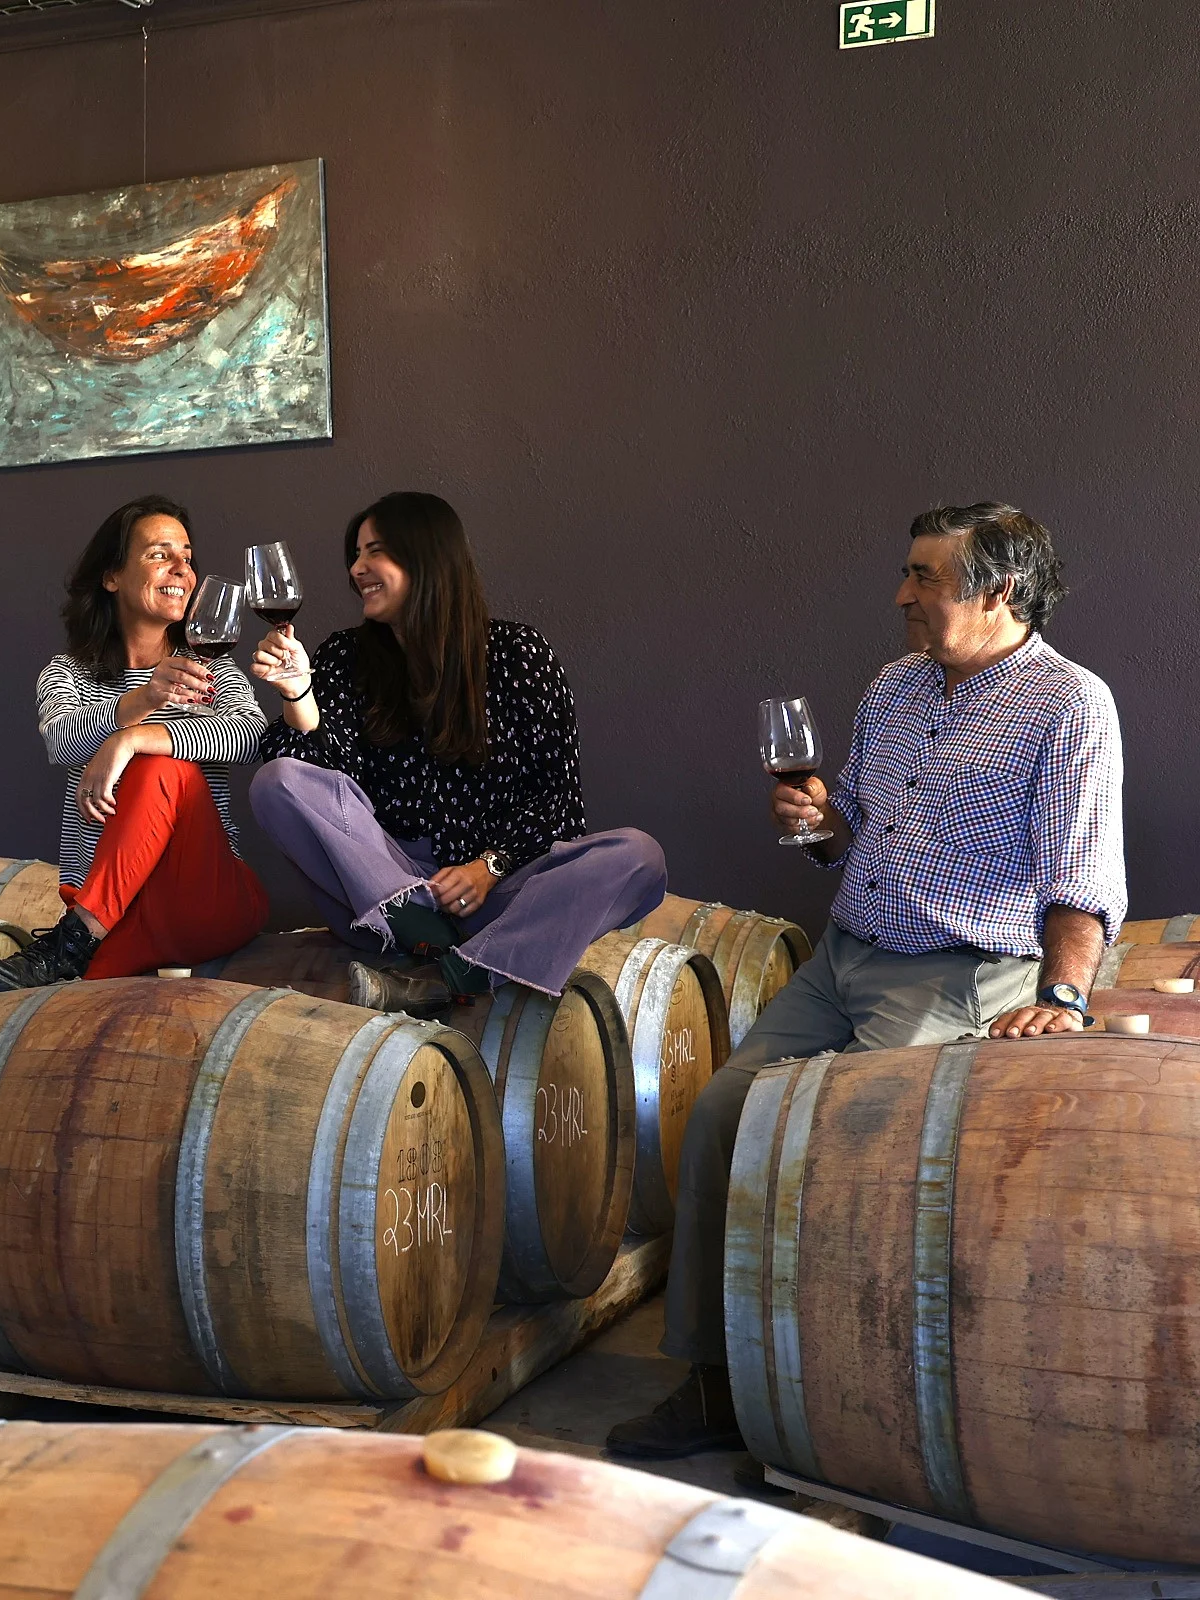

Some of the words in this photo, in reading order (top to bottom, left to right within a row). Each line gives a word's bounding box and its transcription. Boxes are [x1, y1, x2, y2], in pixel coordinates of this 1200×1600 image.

[536, 1083, 588, 1148] 23MRL
[397, 1140, 443, 1184] 1808
[383, 1182, 453, 1257] 23MRL
